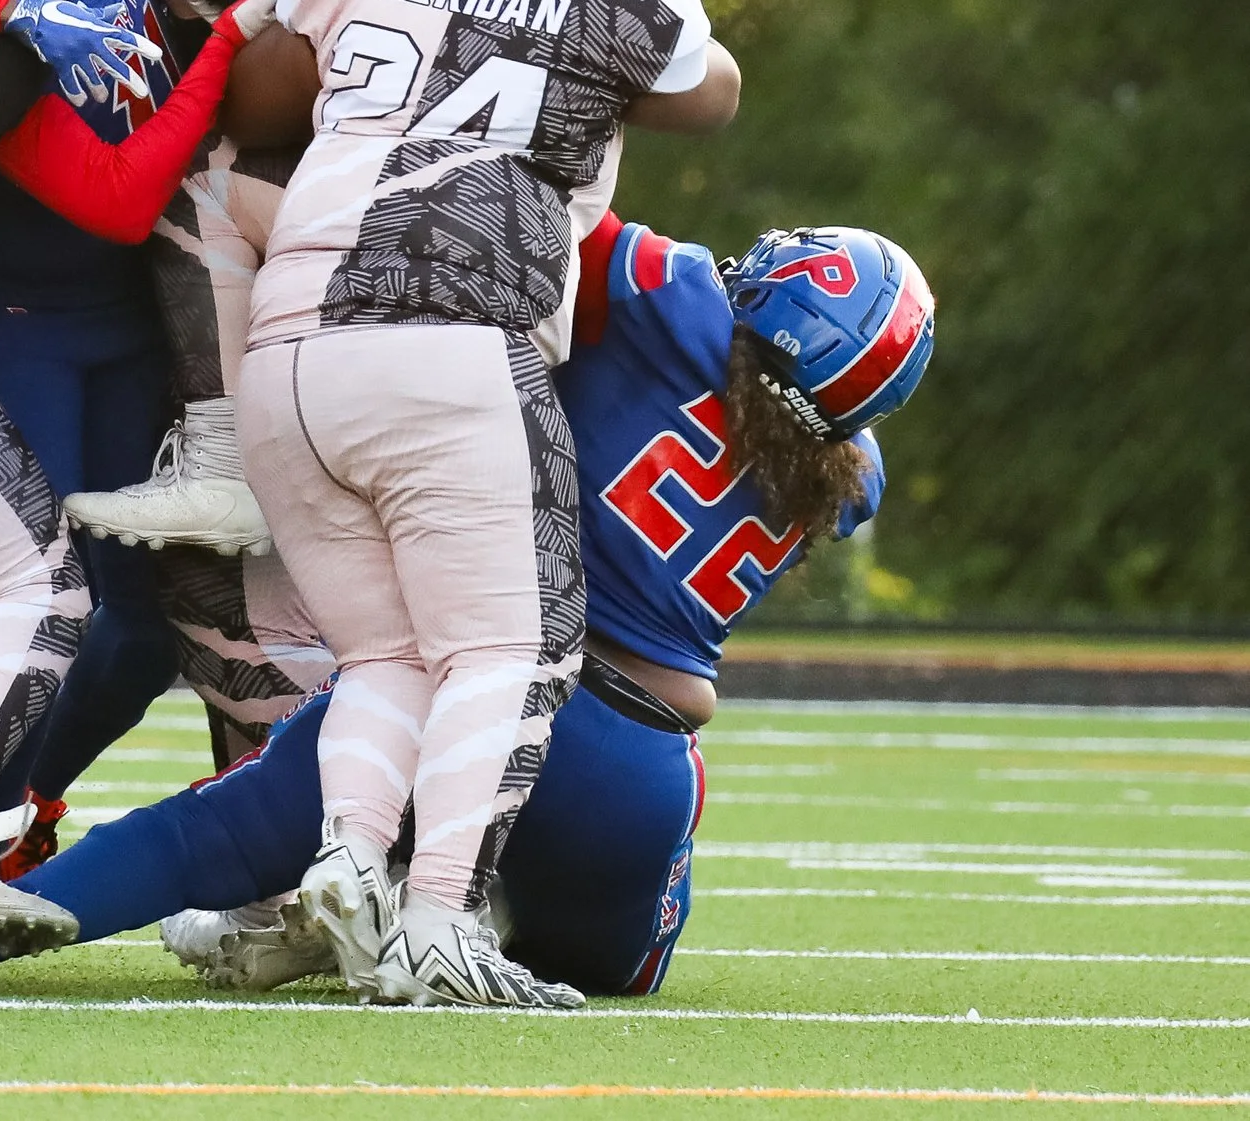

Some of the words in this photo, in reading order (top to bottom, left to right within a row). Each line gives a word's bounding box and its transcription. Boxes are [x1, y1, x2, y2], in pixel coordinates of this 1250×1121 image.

[321, 19, 549, 151] 24
[782, 386, 832, 435] schutt
[599, 389, 806, 625] 22
